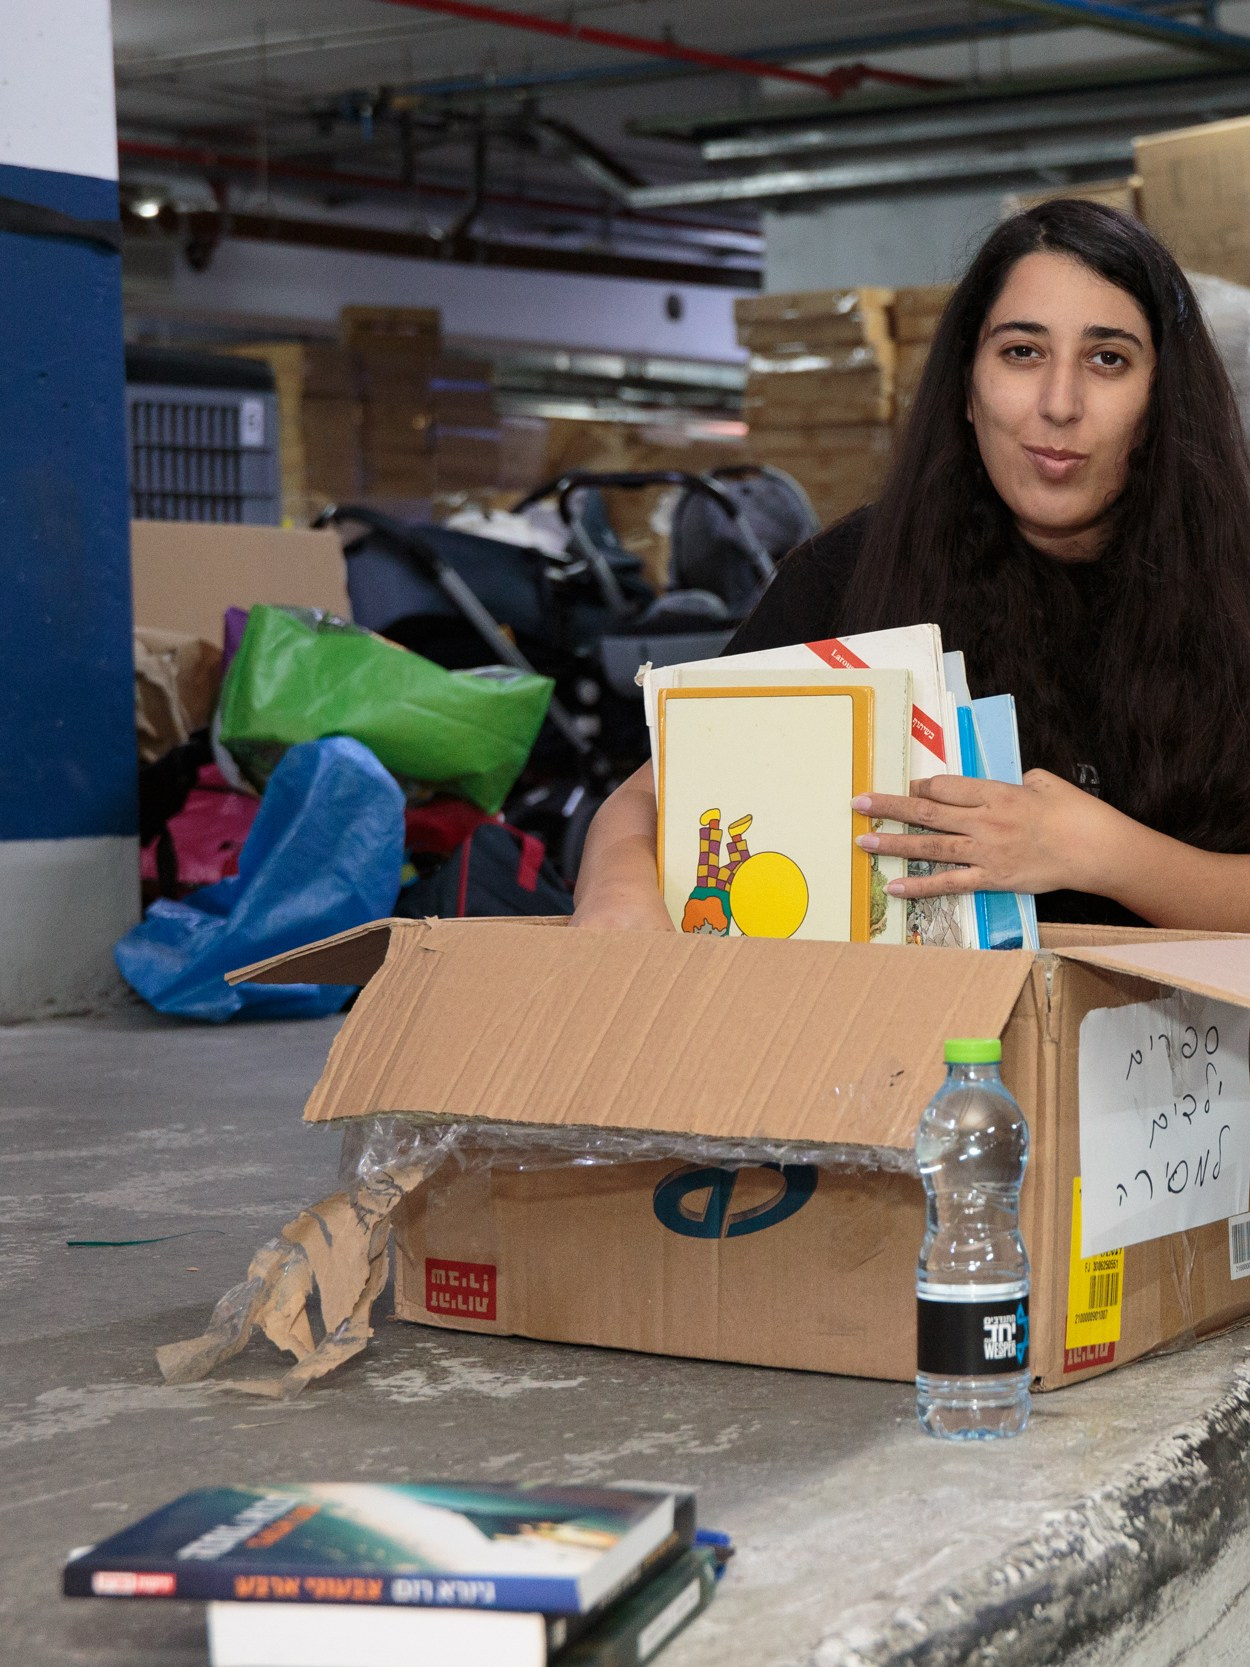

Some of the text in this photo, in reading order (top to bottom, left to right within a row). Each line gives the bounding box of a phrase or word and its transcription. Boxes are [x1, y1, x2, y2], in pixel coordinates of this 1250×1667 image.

[912, 717, 935, 740] בשיתוף
[1125, 1025, 1220, 1081] ספרים
[1149, 1061, 1223, 1149] ילדים
[1116, 1124, 1231, 1207] למסירה
[431, 1291, 488, 1312] זהירות
